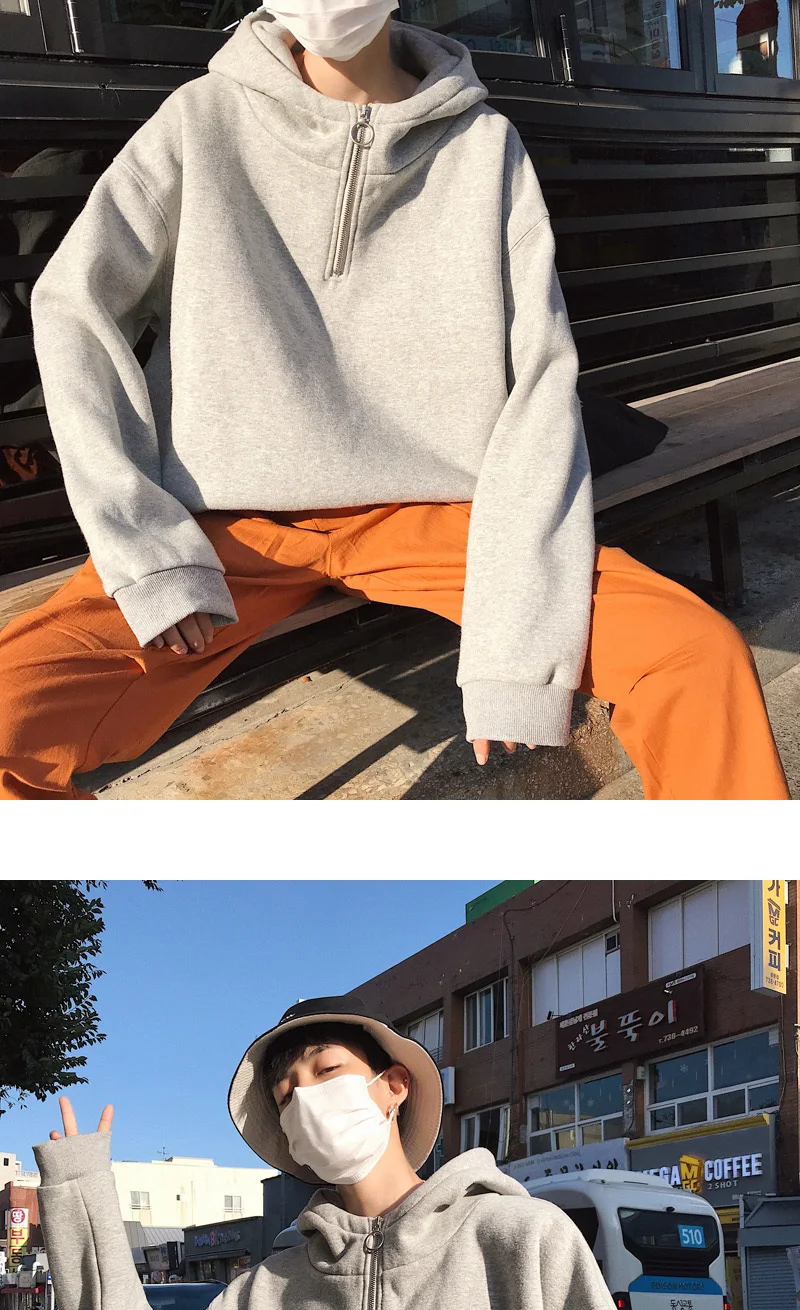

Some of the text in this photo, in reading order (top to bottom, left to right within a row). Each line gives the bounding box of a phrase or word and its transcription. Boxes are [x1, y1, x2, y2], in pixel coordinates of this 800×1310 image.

[768, 928, 781, 972] 커피
[704, 1152, 763, 1182] COFFEE
[682, 1228, 703, 1246] 510
